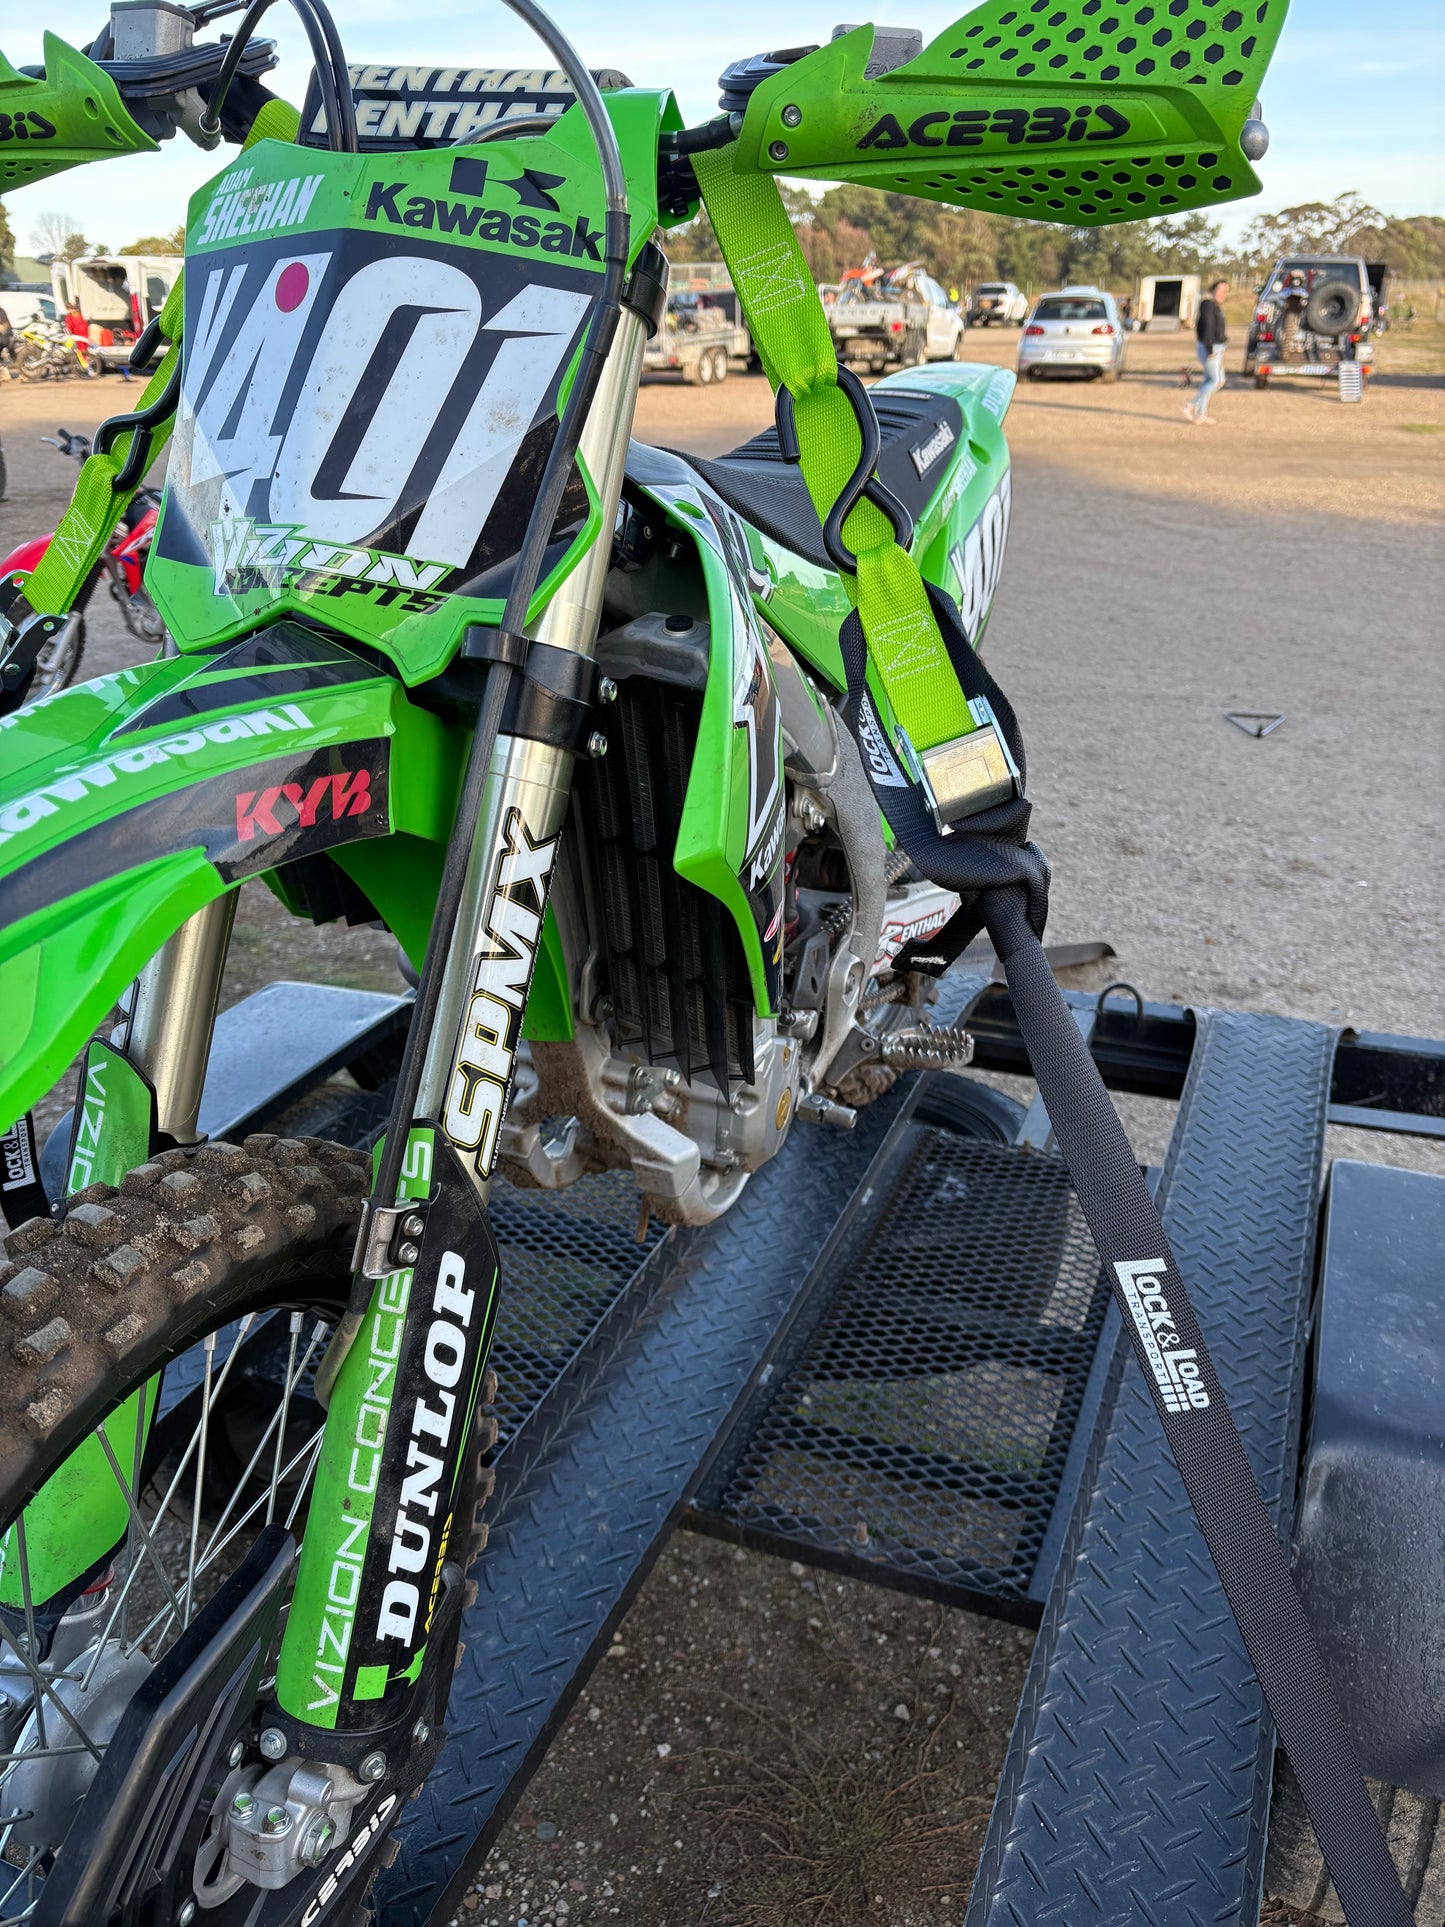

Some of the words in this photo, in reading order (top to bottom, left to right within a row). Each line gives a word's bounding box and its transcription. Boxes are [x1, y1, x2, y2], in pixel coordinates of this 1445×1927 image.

[196, 174, 326, 246] SHEEHAN
[215, 166, 254, 196] ADAM
[364, 181, 607, 262] Kawasak
[911, 420, 955, 475] Kawasaki
[212, 518, 449, 592] VIZION
[226, 567, 450, 615] CONCEPTS
[0, 703, 314, 845] awasaki
[859, 724, 909, 788] LOCK
[235, 769, 372, 842] KYB
[445, 811, 557, 1178] SPMX
[68, 1061, 107, 1195] VIZIO
[2, 1148, 36, 1192] LOCK
[1113, 1258, 1176, 1332] LOCK
[1127, 1292, 1167, 1379] TRANSPORT
[1156, 1332, 1180, 1349] &
[1161, 1348, 1211, 1409] LOAD
[306, 1514, 368, 1711] VIZION
[347, 1141, 431, 1495] CONCES
[376, 1250, 476, 1648] DUNLOP
